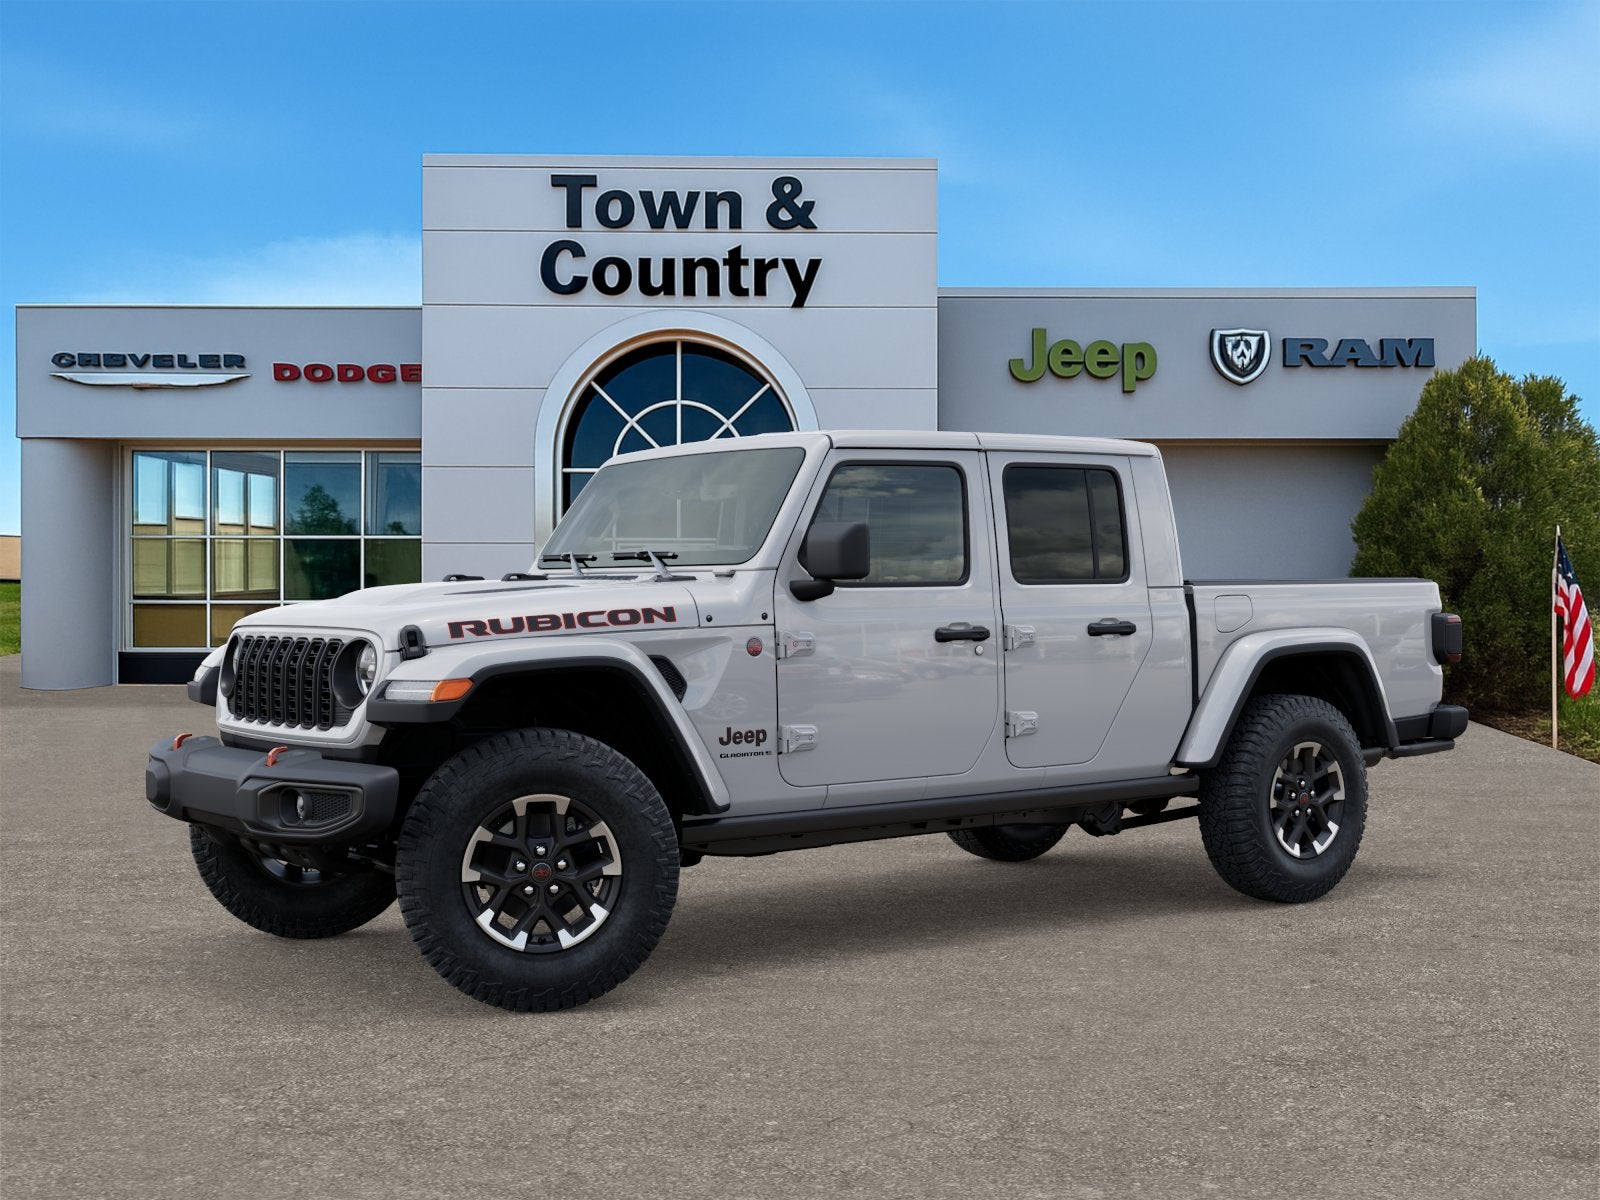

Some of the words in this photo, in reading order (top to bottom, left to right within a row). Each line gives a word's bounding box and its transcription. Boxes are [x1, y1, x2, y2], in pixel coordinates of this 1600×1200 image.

[550, 174, 742, 229] Town
[765, 176, 818, 229] &
[540, 239, 822, 308] Country
[1009, 328, 1157, 393] Jeep
[1282, 338, 1435, 368] RAM
[273, 363, 422, 383] DODGE
[447, 606, 677, 639] RUBICON
[718, 727, 767, 746] Jeep
[720, 751, 764, 759] GLADIATOR
